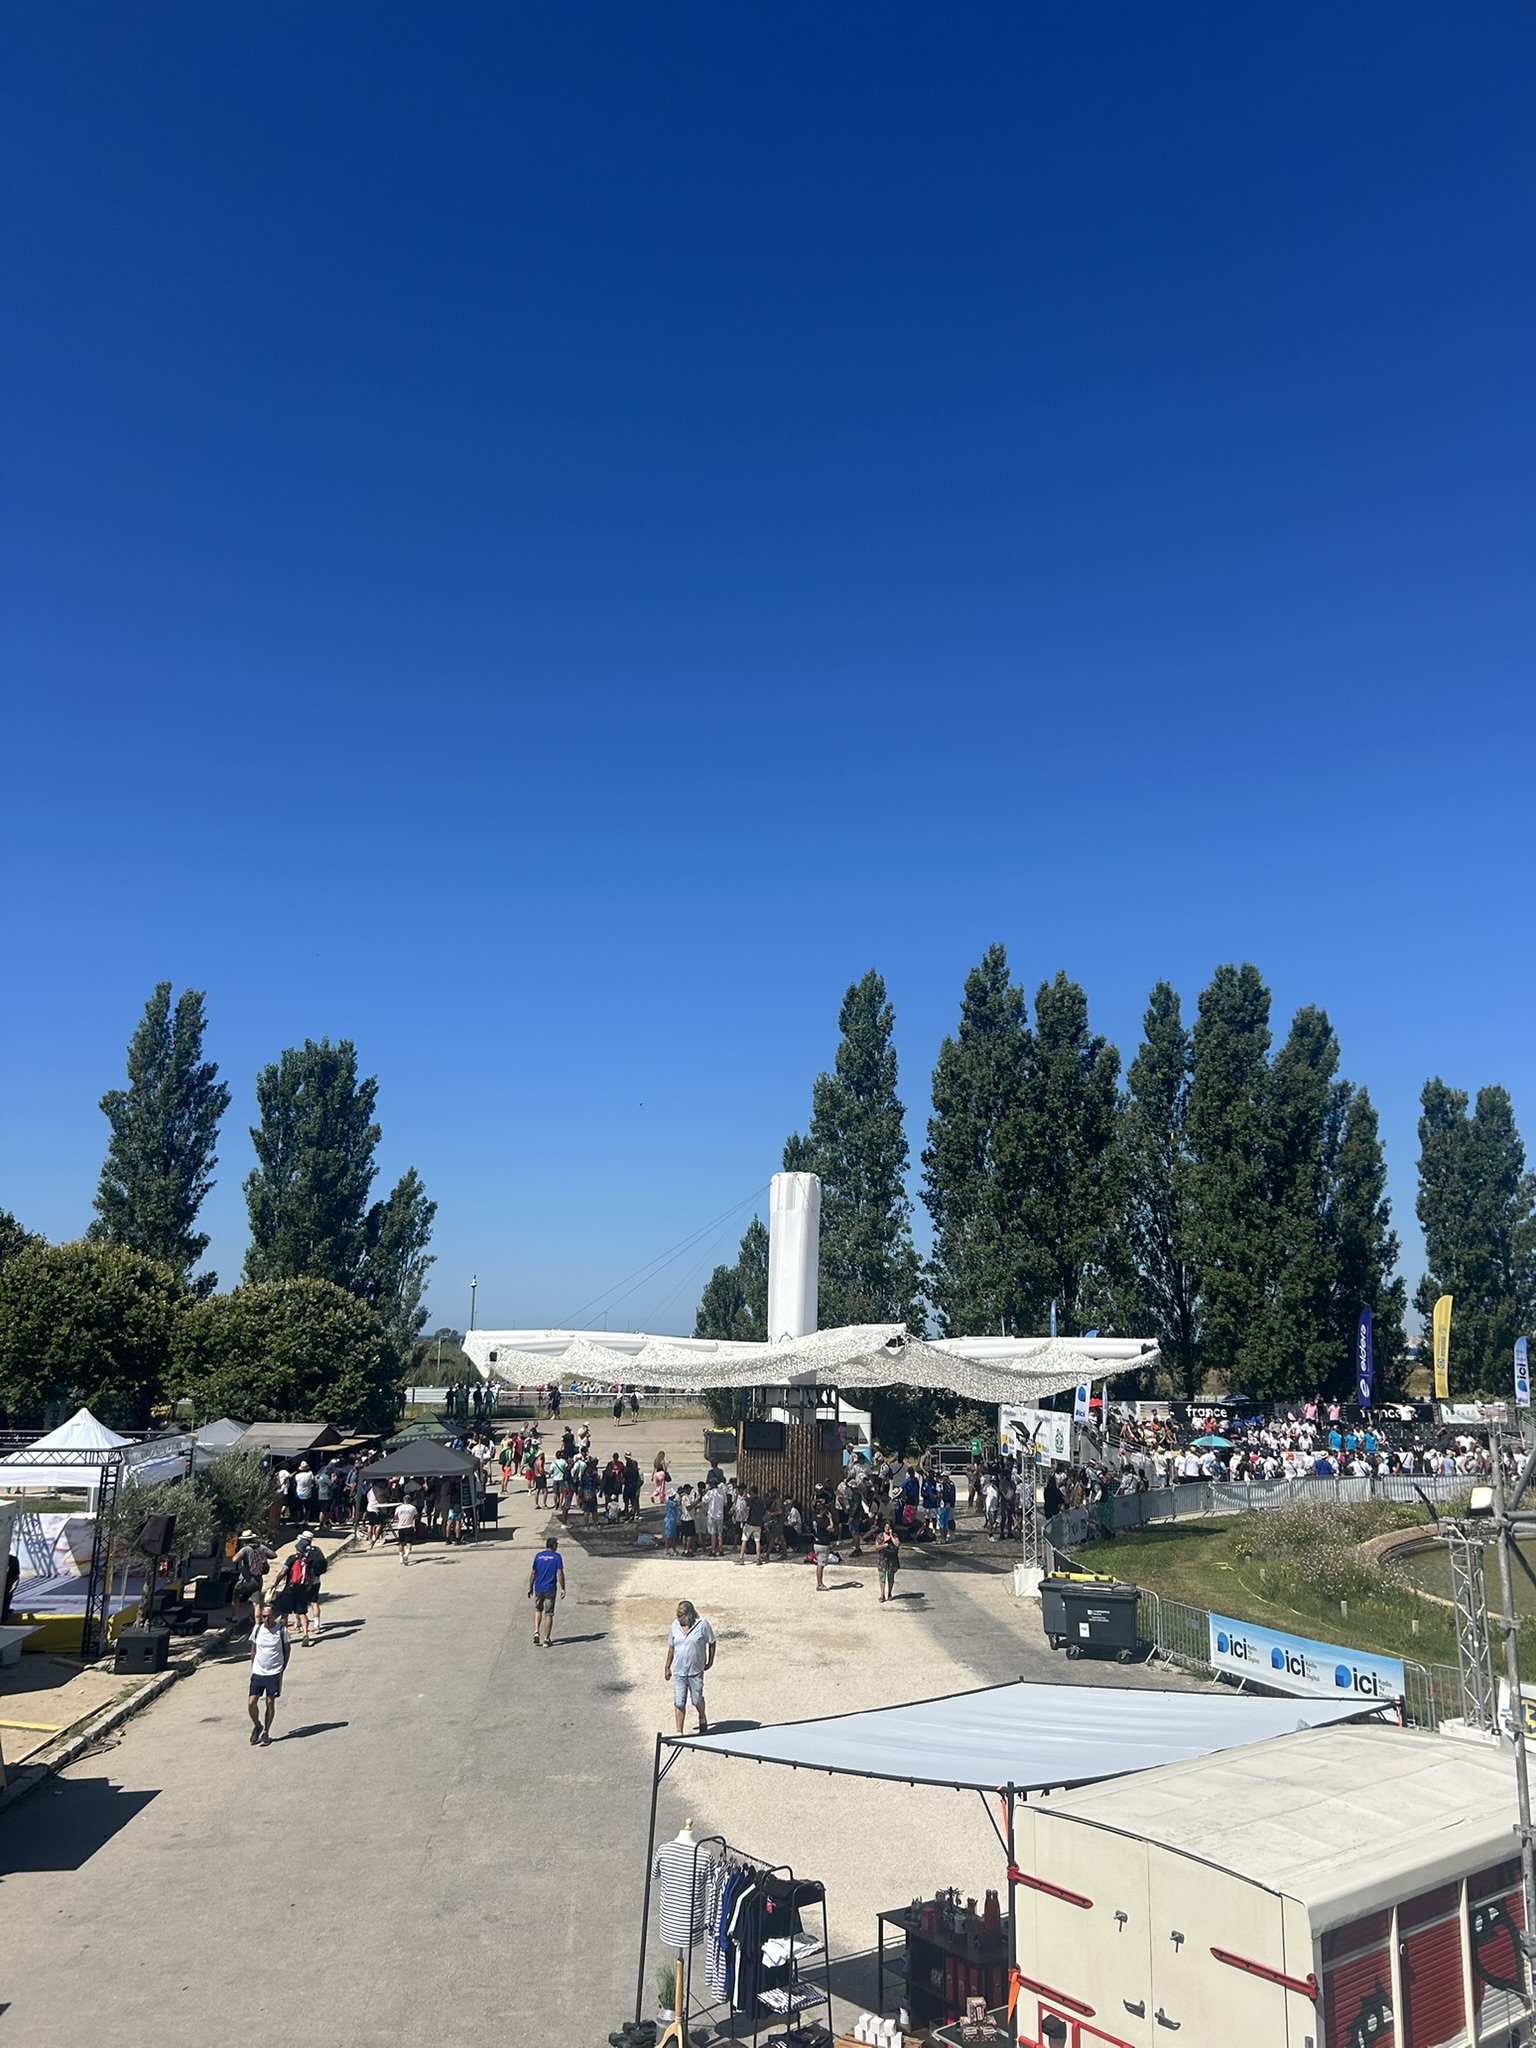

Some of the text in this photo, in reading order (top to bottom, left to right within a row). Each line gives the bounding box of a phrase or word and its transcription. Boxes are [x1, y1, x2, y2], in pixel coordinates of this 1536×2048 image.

[1359, 1324, 1367, 1372] eldera
[1517, 1363, 1527, 1380] ici
[1185, 1405, 1228, 1418] france
[385, 1434, 458, 1445] Heineken
[1229, 1634, 1248, 1661] ici
[1285, 1650, 1306, 1678] ici
[1305, 1660, 1318, 1669] Radio
[1306, 1673, 1320, 1682] Digital
[1352, 1667, 1378, 1696] ici
[1378, 1679, 1392, 1687] Radio
